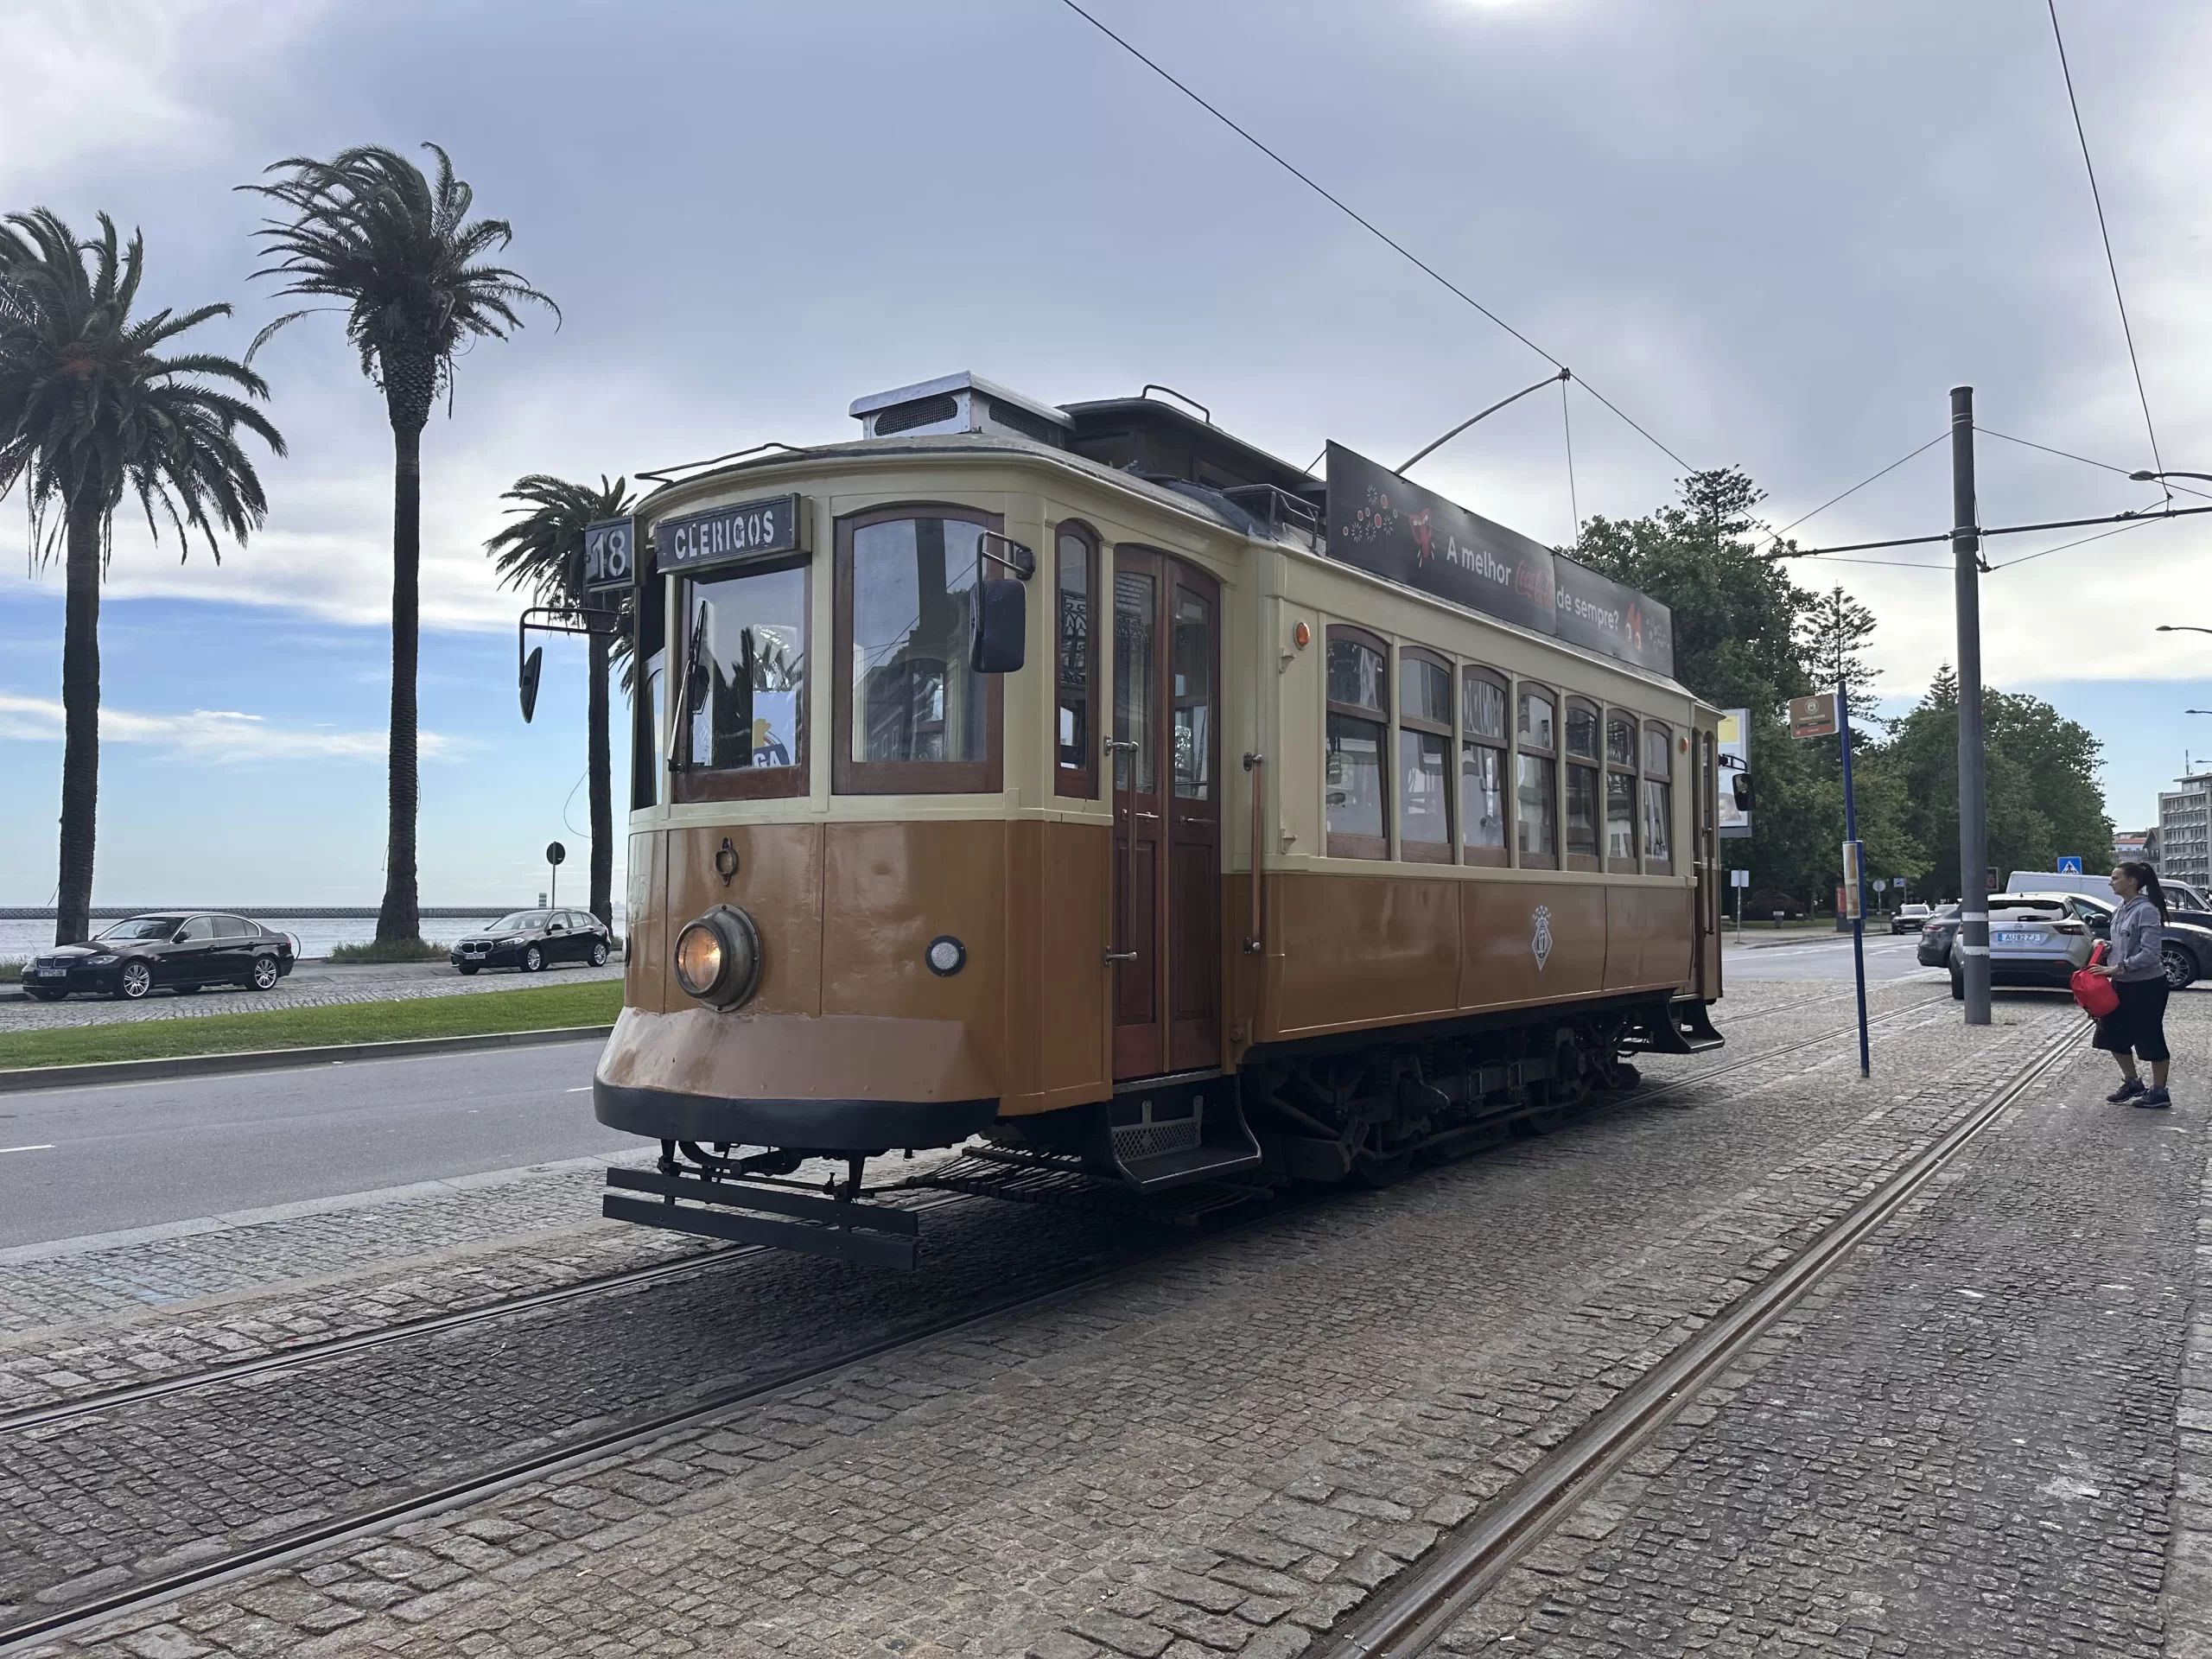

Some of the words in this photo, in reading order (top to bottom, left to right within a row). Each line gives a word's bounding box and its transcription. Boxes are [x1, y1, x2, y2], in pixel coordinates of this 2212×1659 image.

[590, 529, 626, 579] 18
[674, 510, 774, 560] CLERIGOS
[1446, 536, 1458, 564] A
[1462, 546, 1511, 586] melhor
[1556, 586, 1572, 612] de
[1574, 596, 1619, 632] sempre?
